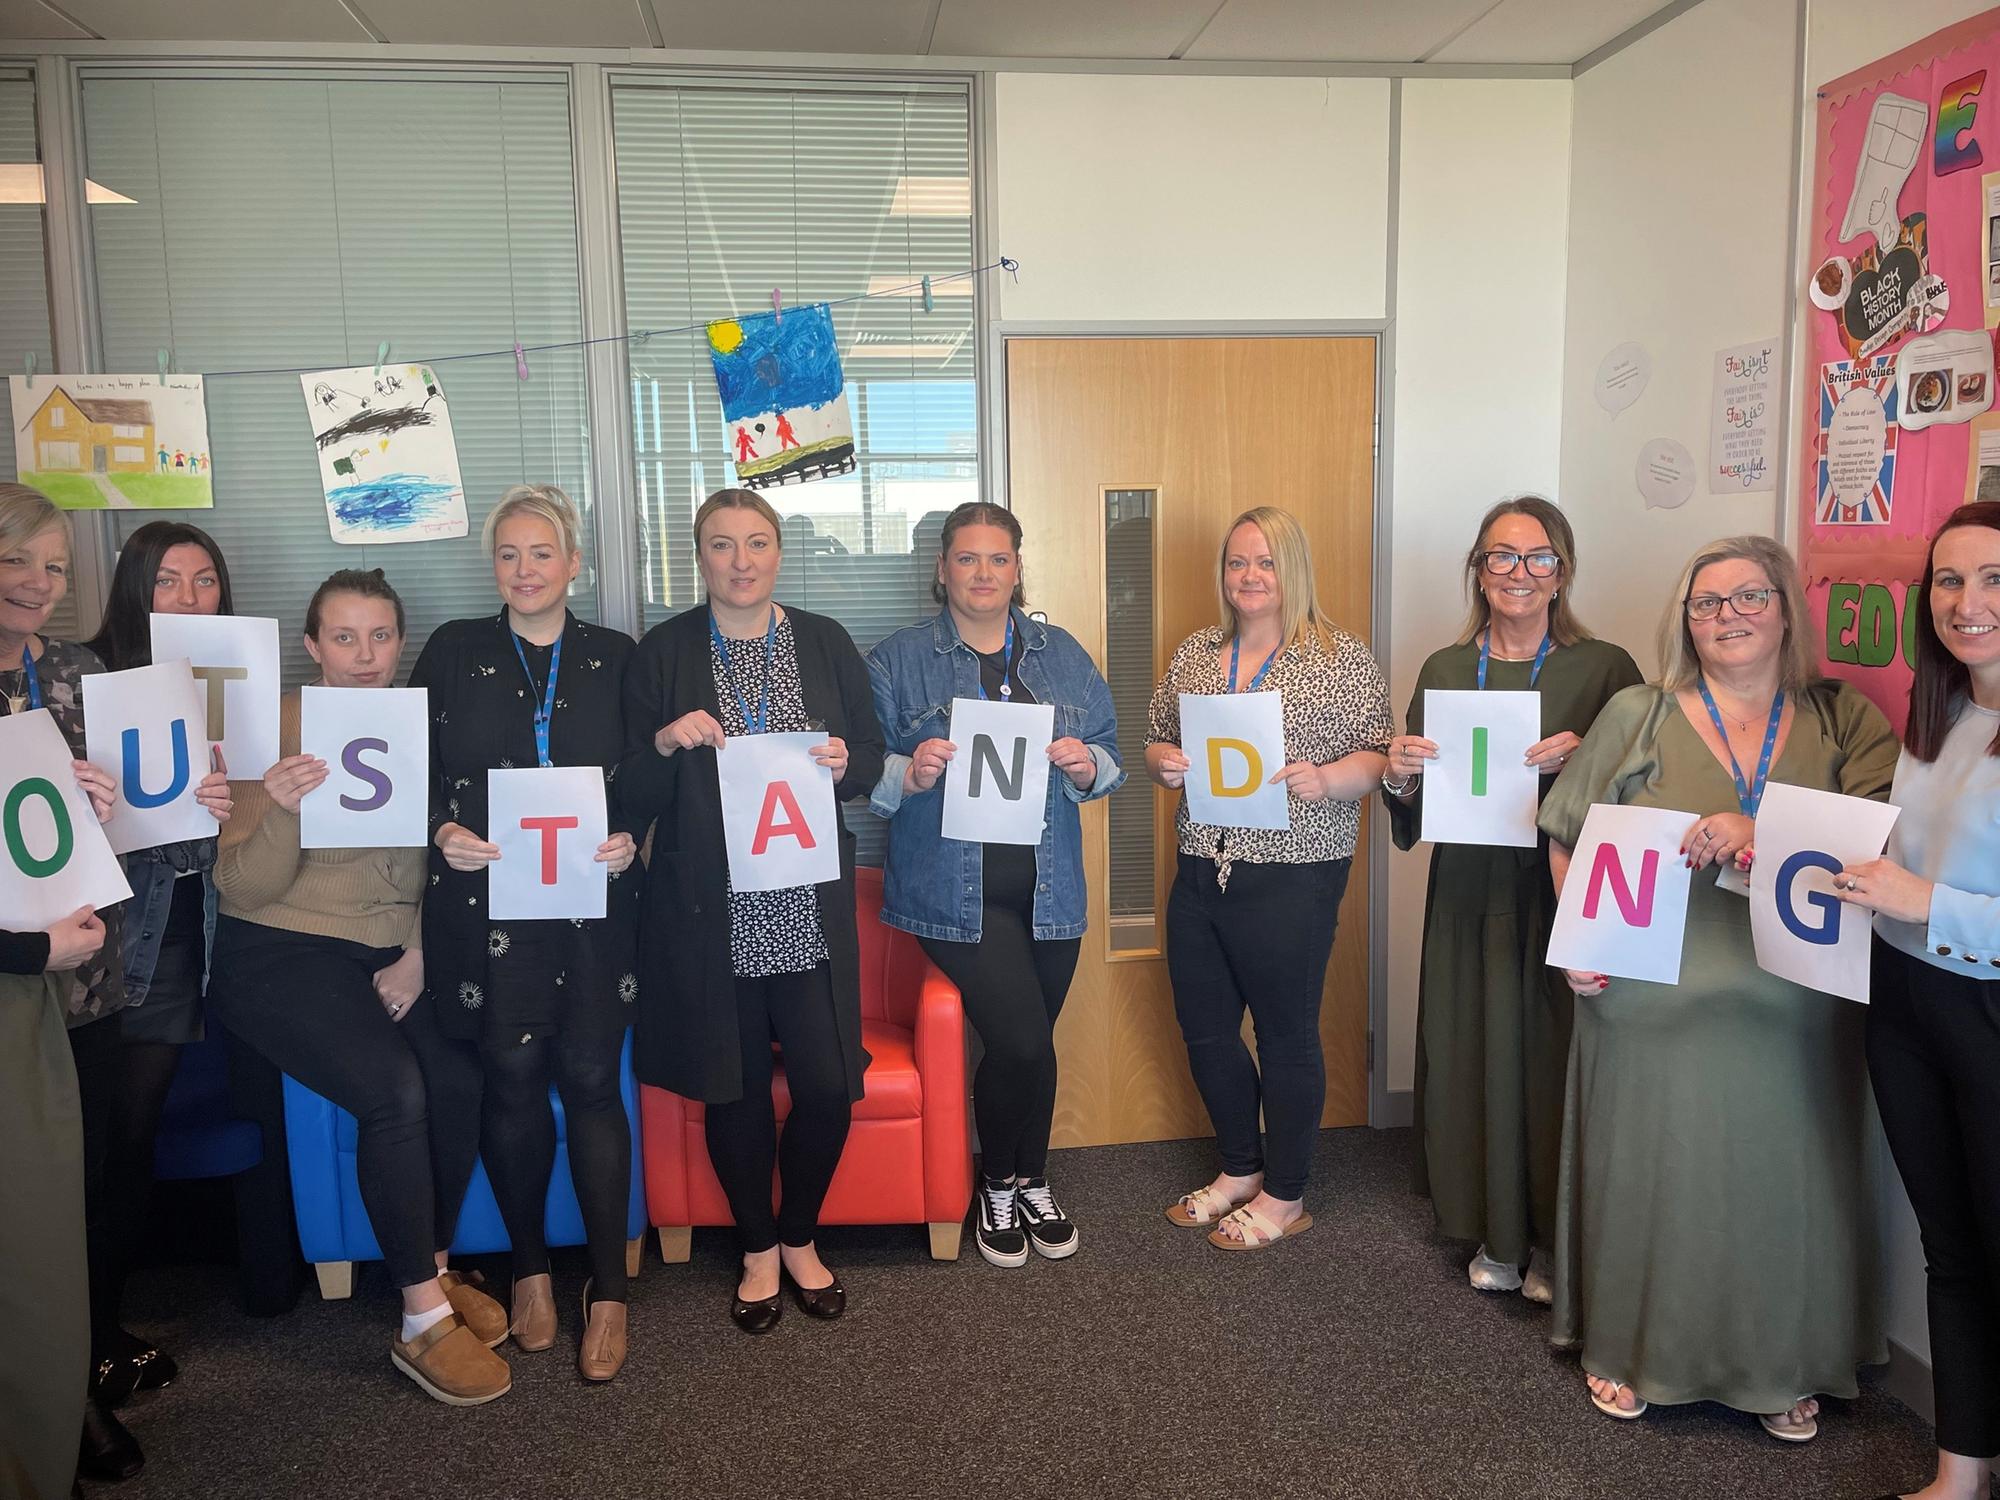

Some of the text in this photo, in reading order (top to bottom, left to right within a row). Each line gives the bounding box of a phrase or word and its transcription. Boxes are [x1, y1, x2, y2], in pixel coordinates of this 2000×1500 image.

[1935, 69, 1987, 177] E
[1860, 267, 1900, 306] BLACK
[1863, 282, 1901, 319] HISTORY
[1868, 299, 1902, 331] MONTH
[1725, 356, 1751, 377] Fair
[1828, 366, 1896, 384] British Values
[1727, 406, 1752, 428] Fair
[192, 666, 248, 741] T
[121, 718, 190, 809] U
[339, 737, 393, 812] S
[967, 733, 1026, 801] N
[1206, 737, 1263, 798] D
[1471, 727, 1488, 797] I
[3, 777, 74, 879] O
[519, 816, 578, 885] T
[750, 780, 817, 855] A
[1582, 842, 1660, 928] N
[1775, 850, 1844, 945] G
